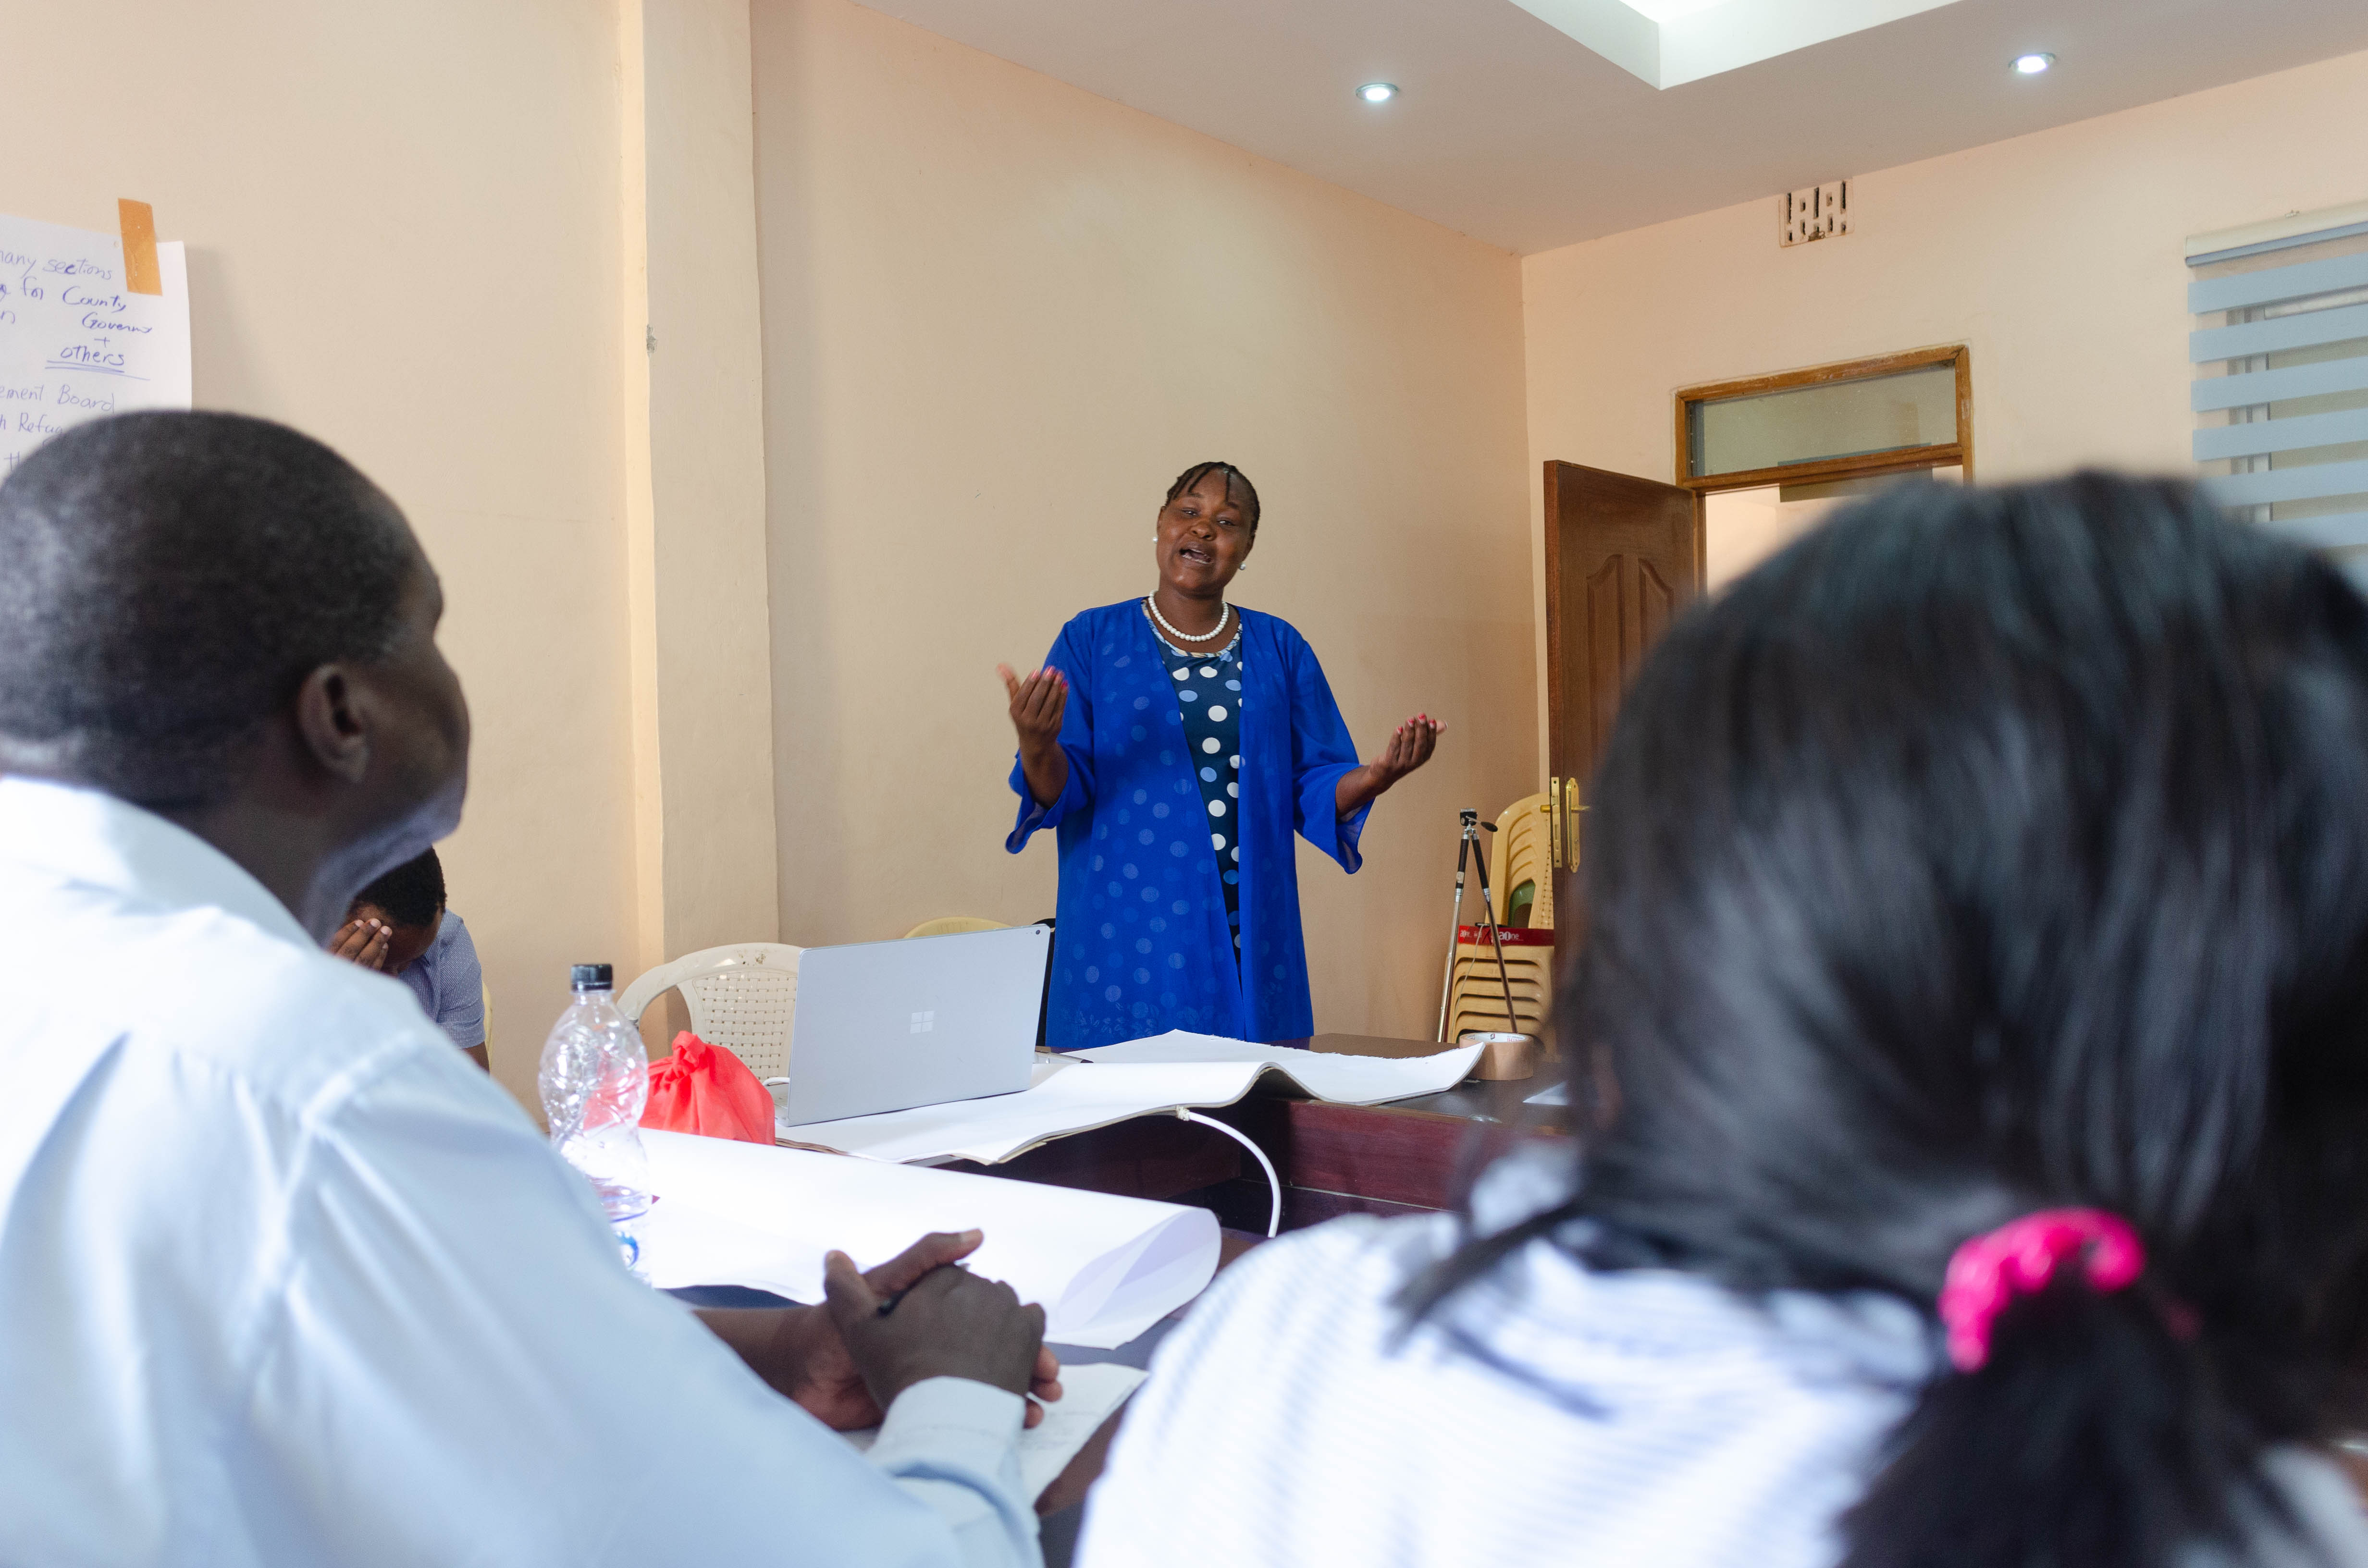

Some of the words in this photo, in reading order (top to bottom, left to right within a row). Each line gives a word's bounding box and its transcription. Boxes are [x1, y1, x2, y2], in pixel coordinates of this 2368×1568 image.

[62, 286, 126, 313] County
[61, 345, 124, 366] others
[57, 384, 114, 413] Board
